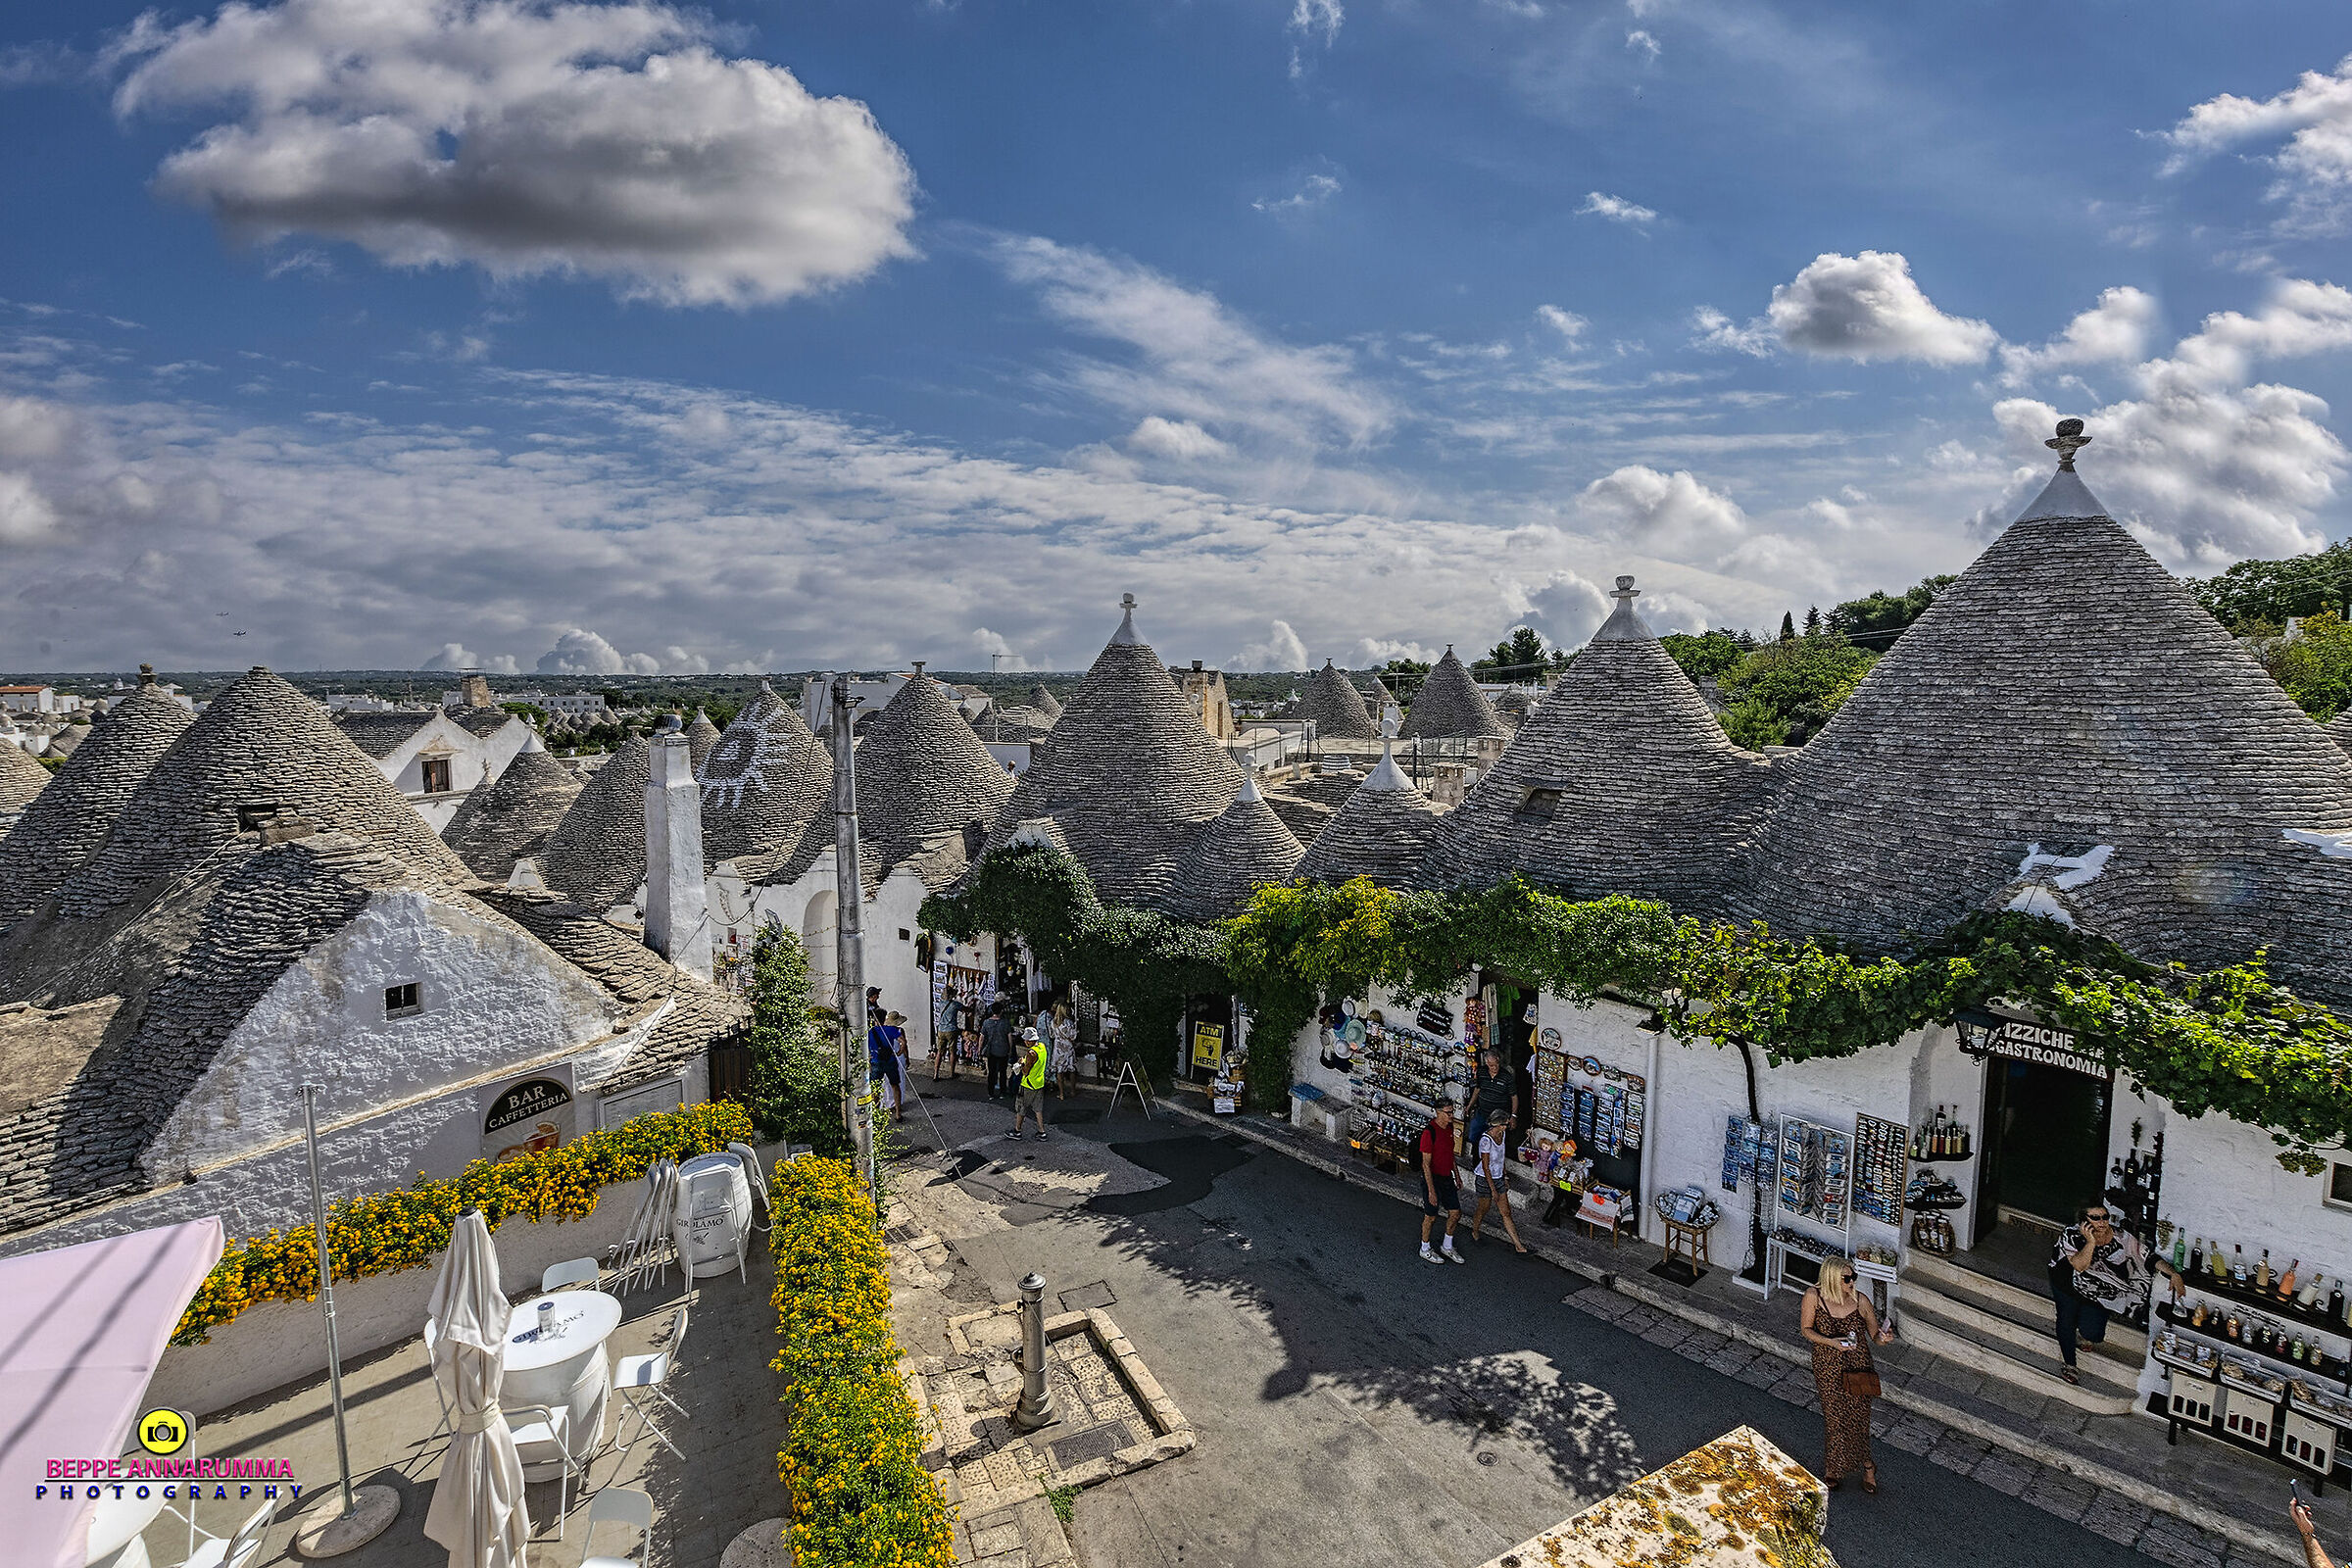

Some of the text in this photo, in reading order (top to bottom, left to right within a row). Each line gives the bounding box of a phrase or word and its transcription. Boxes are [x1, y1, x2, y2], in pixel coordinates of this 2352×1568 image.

[1200, 1026, 1219, 1037] ATM
[1195, 1055, 1218, 1067] HERE
[1995, 1039, 2108, 1079] GASTRONOMIA
[509, 1085, 546, 1109] BAR
[489, 1092, 568, 1128] CAFFETTERIA
